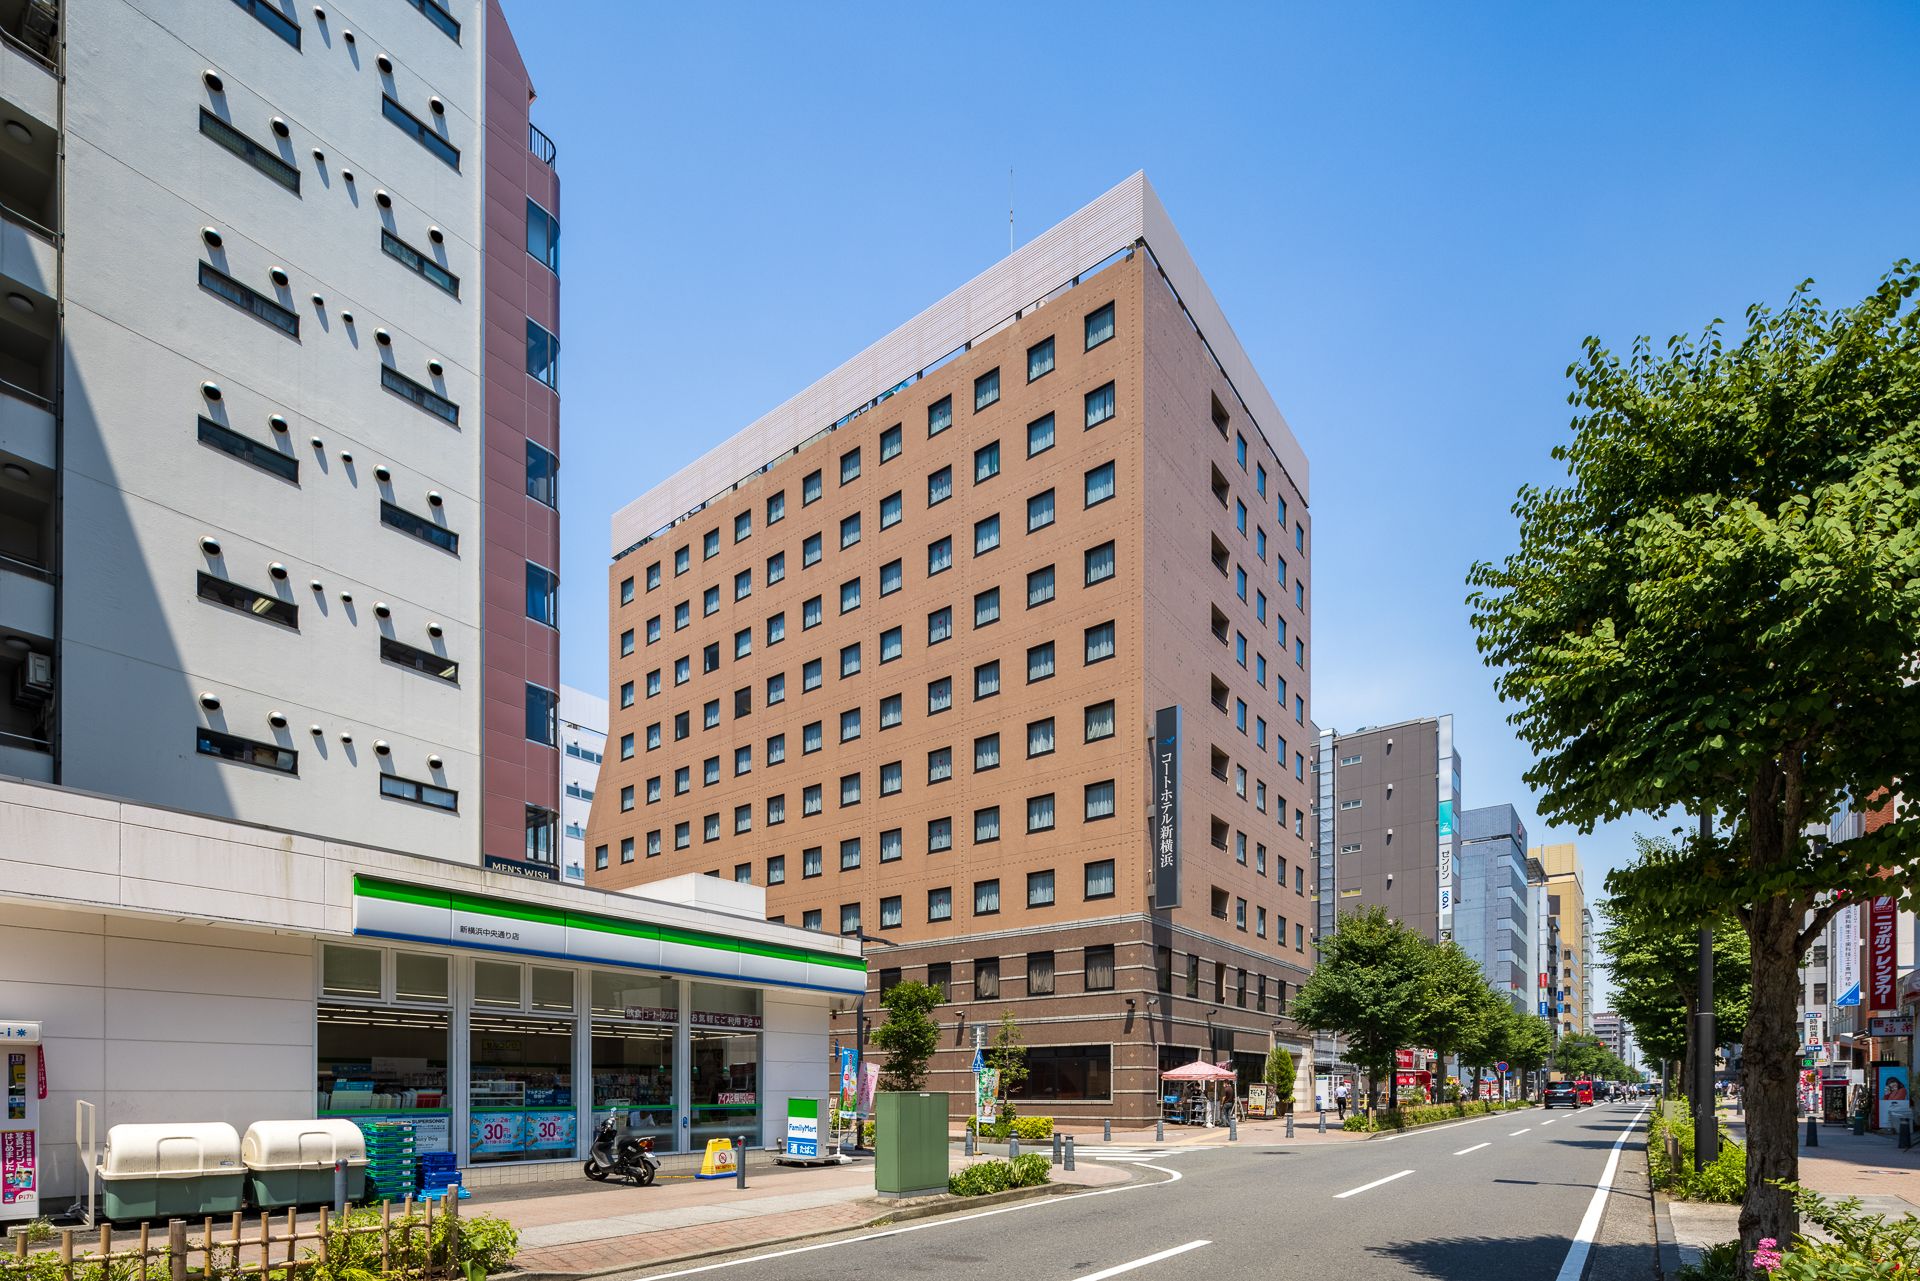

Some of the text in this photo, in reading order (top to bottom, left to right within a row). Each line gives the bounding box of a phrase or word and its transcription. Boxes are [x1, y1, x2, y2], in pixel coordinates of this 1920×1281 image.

[1159, 752, 1174, 868] コートホテル新横浜
[492, 862, 550, 880] MEN'S WISH
[460, 925, 520, 941] 新横浜中央通り店
[1874, 915, 1893, 1004] ニッポンレンタカー
[484, 1123, 503, 1140] 30
[538, 1121, 556, 1138] 30
[789, 1123, 817, 1133] FamilyMart
[790, 1143, 815, 1155] 酒 たばこ
